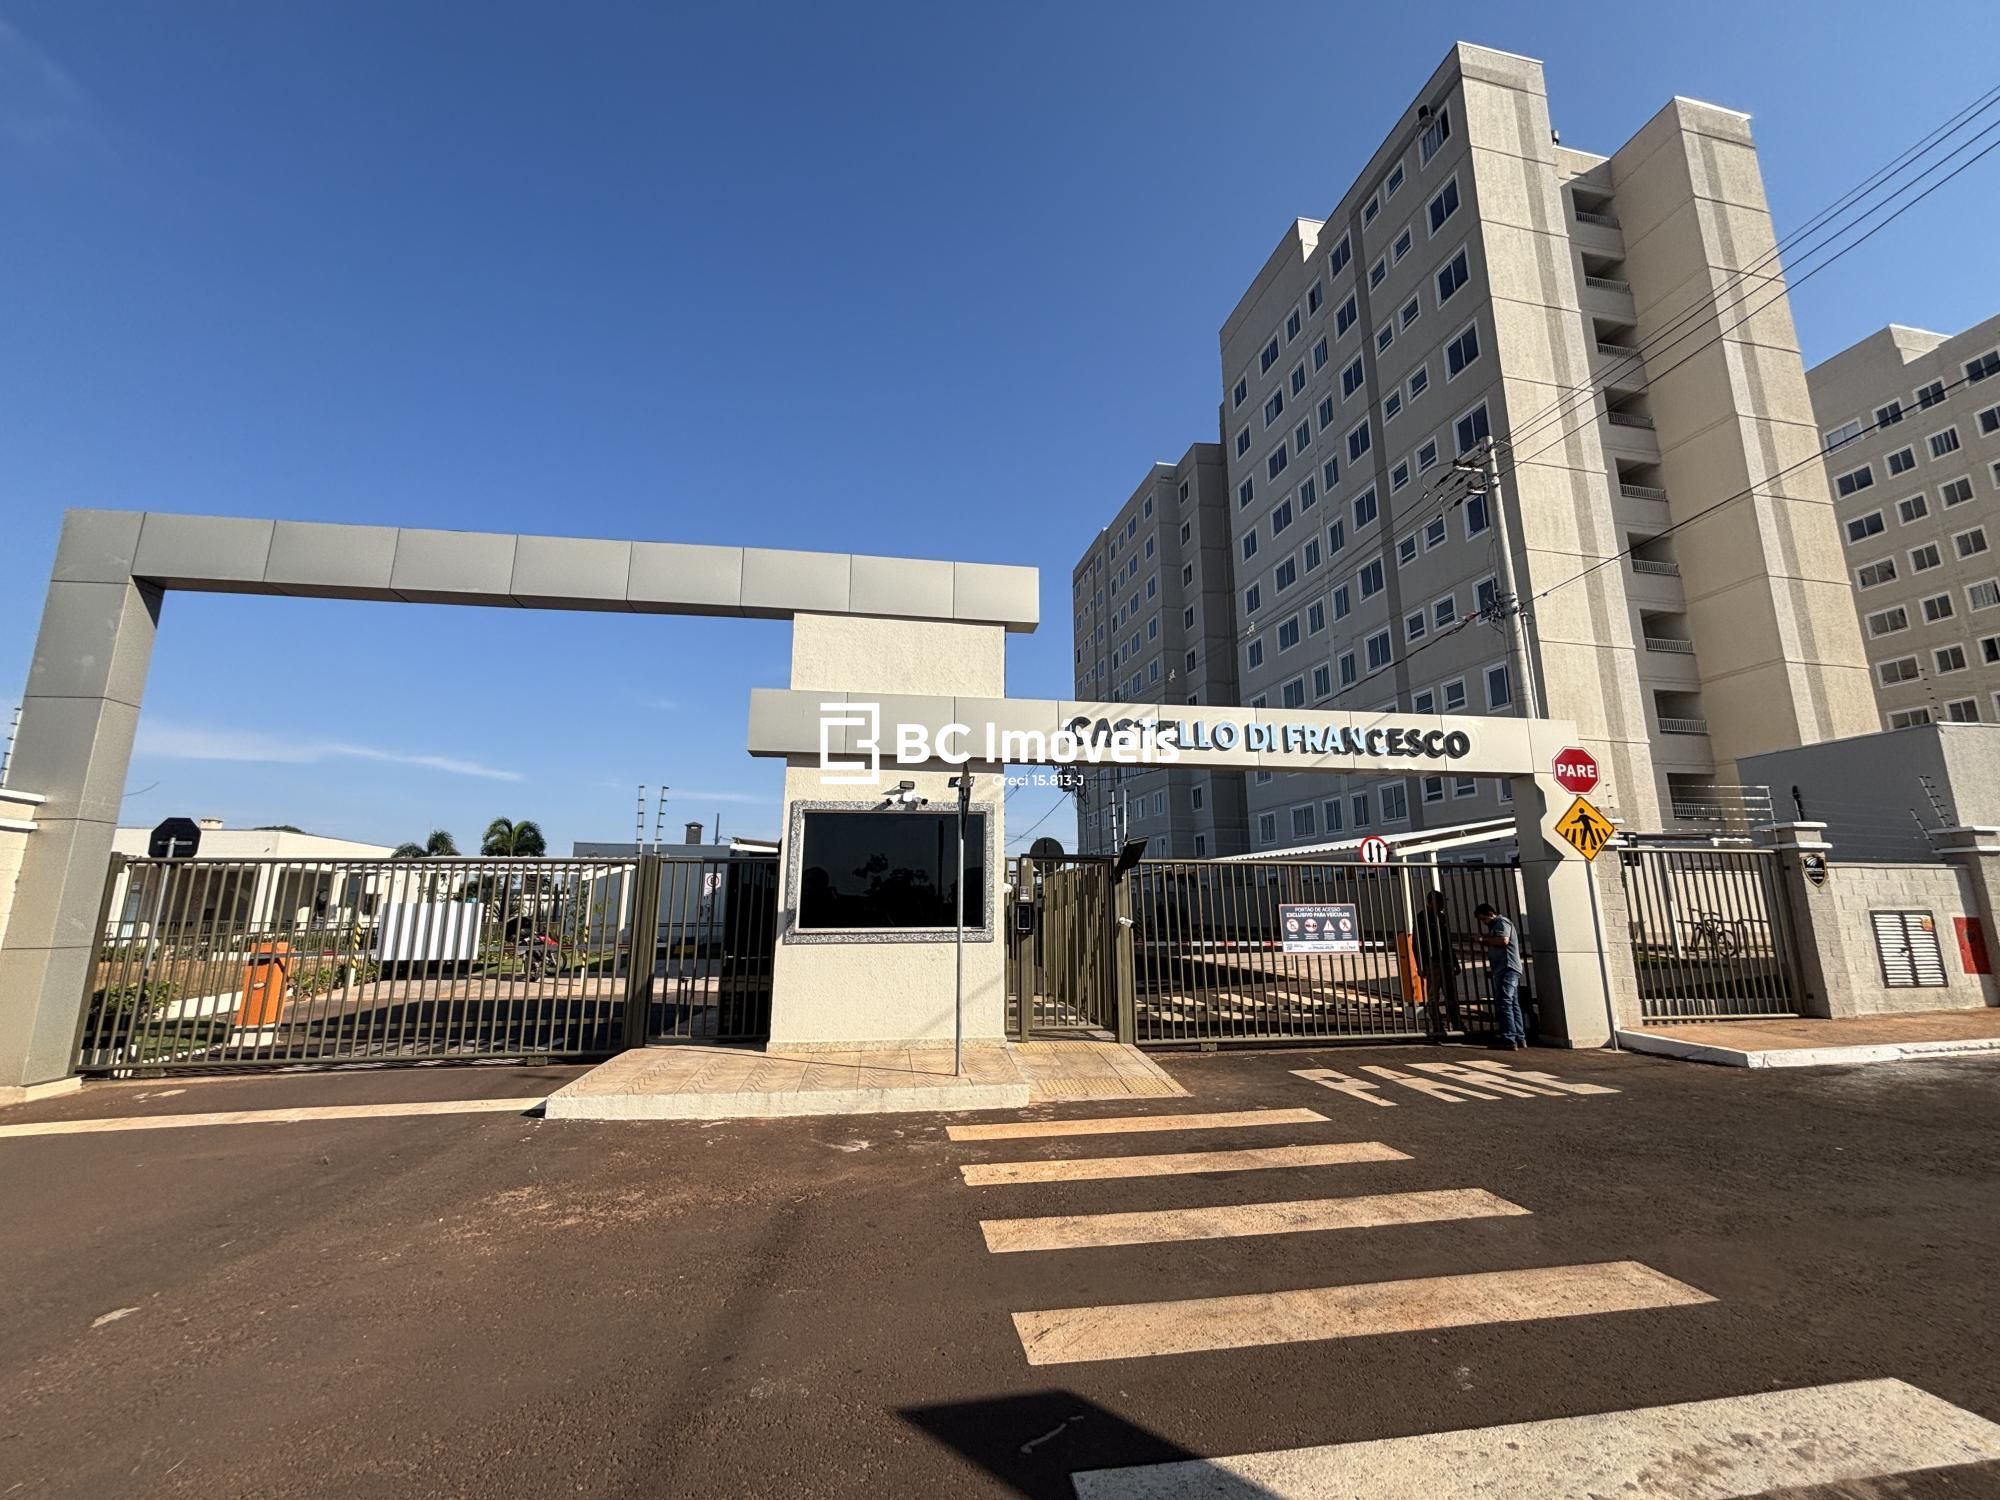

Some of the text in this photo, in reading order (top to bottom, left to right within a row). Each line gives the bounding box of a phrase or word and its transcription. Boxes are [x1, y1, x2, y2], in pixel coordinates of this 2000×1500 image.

[1244, 722, 1278, 751] DI
[1281, 724, 1471, 760] FRANCESCO
[1557, 763, 1596, 778] PARE
[1287, 1060, 1622, 1107] PARE
